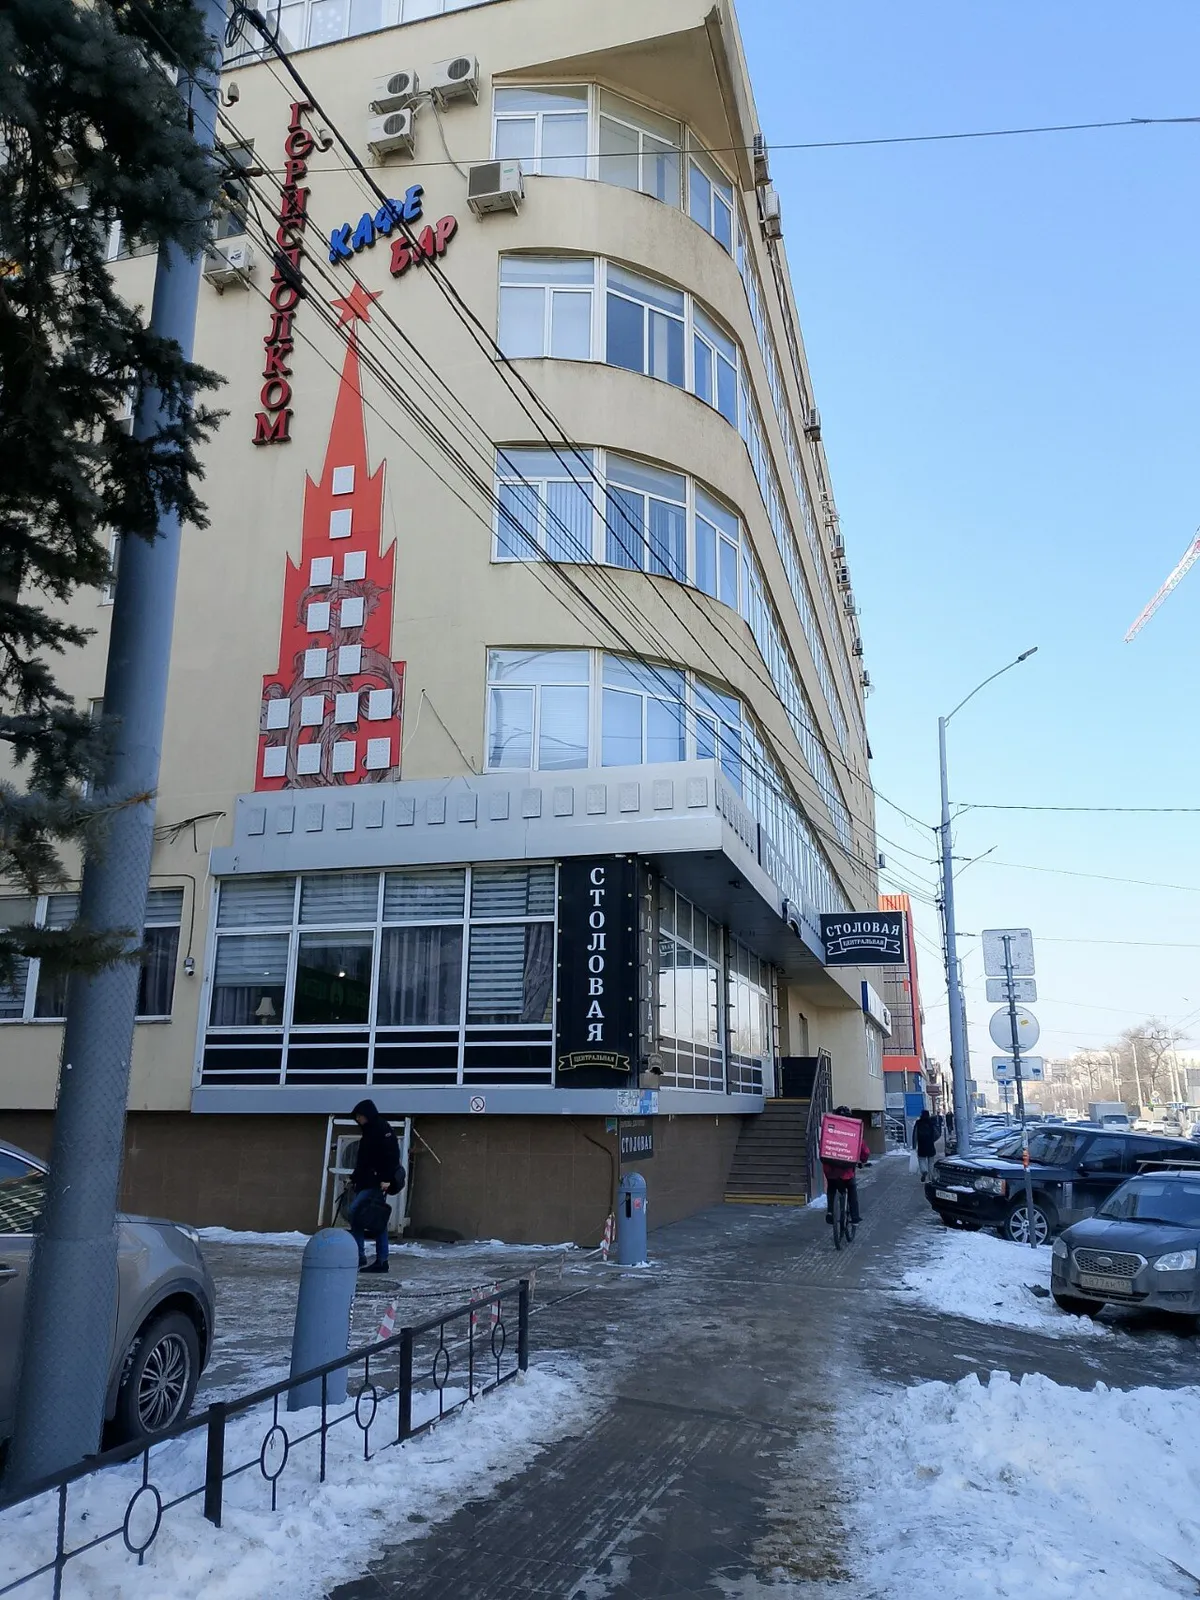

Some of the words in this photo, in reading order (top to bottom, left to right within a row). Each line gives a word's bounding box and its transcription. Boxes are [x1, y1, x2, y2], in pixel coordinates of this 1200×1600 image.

[329, 184, 424, 265] КАФЕ
[390, 215, 457, 276] БАР
[586, 867, 606, 1042] СТОЛОВАЯ
[826, 921, 900, 937] СТОЛОВАЯ
[573, 1054, 615, 1062] ЦЕНТРАЛЬНАЯ
